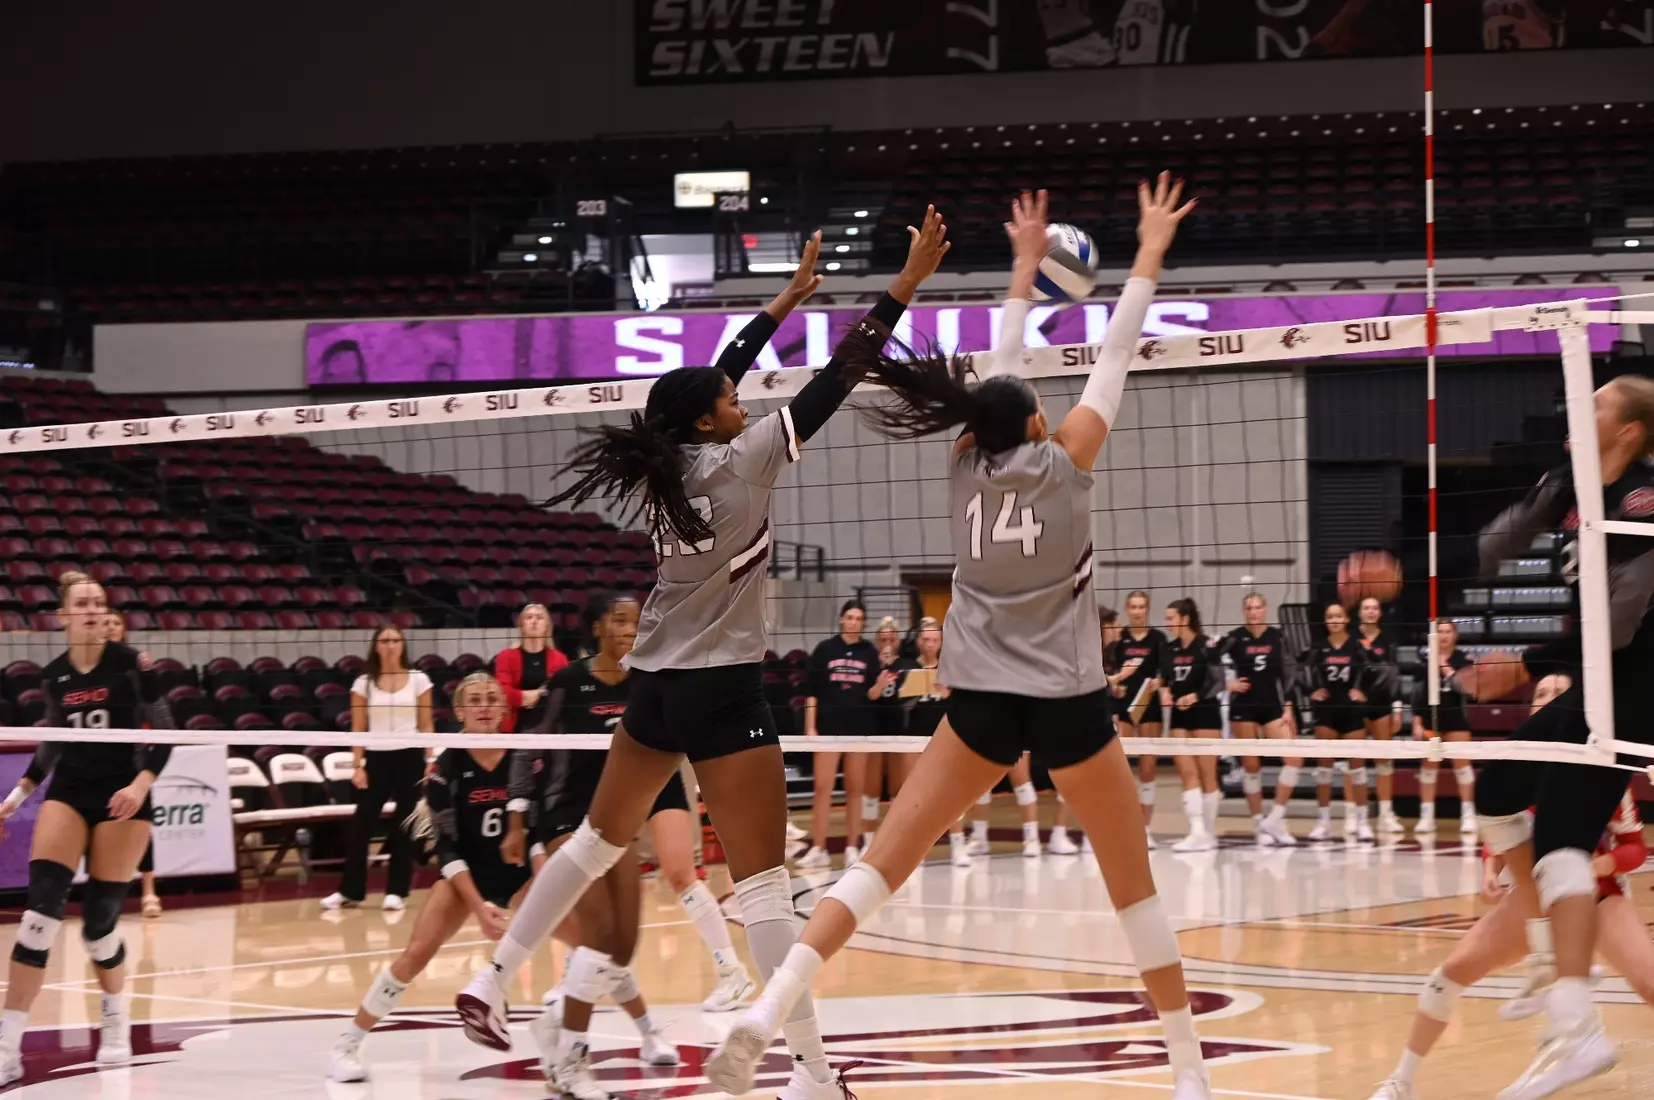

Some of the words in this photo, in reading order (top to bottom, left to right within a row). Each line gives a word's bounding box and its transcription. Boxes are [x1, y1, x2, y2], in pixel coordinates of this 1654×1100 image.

[649, 0, 838, 31] SWEET
[649, 32, 895, 76] SIXTEEN
[719, 195, 749, 211] 204
[41, 427, 68, 443] SIU
[122, 421, 149, 438] SIU
[205, 414, 235, 431] SIU
[295, 408, 324, 424] SIU
[388, 401, 419, 418] SIU
[486, 393, 518, 411] SIU
[589, 385, 623, 403] SIU
[1198, 334, 1245, 357] SIU
[1343, 320, 1391, 344] SIU
[964, 488, 1045, 560] 14
[1172, 665, 1193, 682] 17
[1326, 665, 1351, 683] 24
[66, 708, 110, 729] 19
[151, 803, 204, 827] erra
[481, 808, 504, 837] 6
